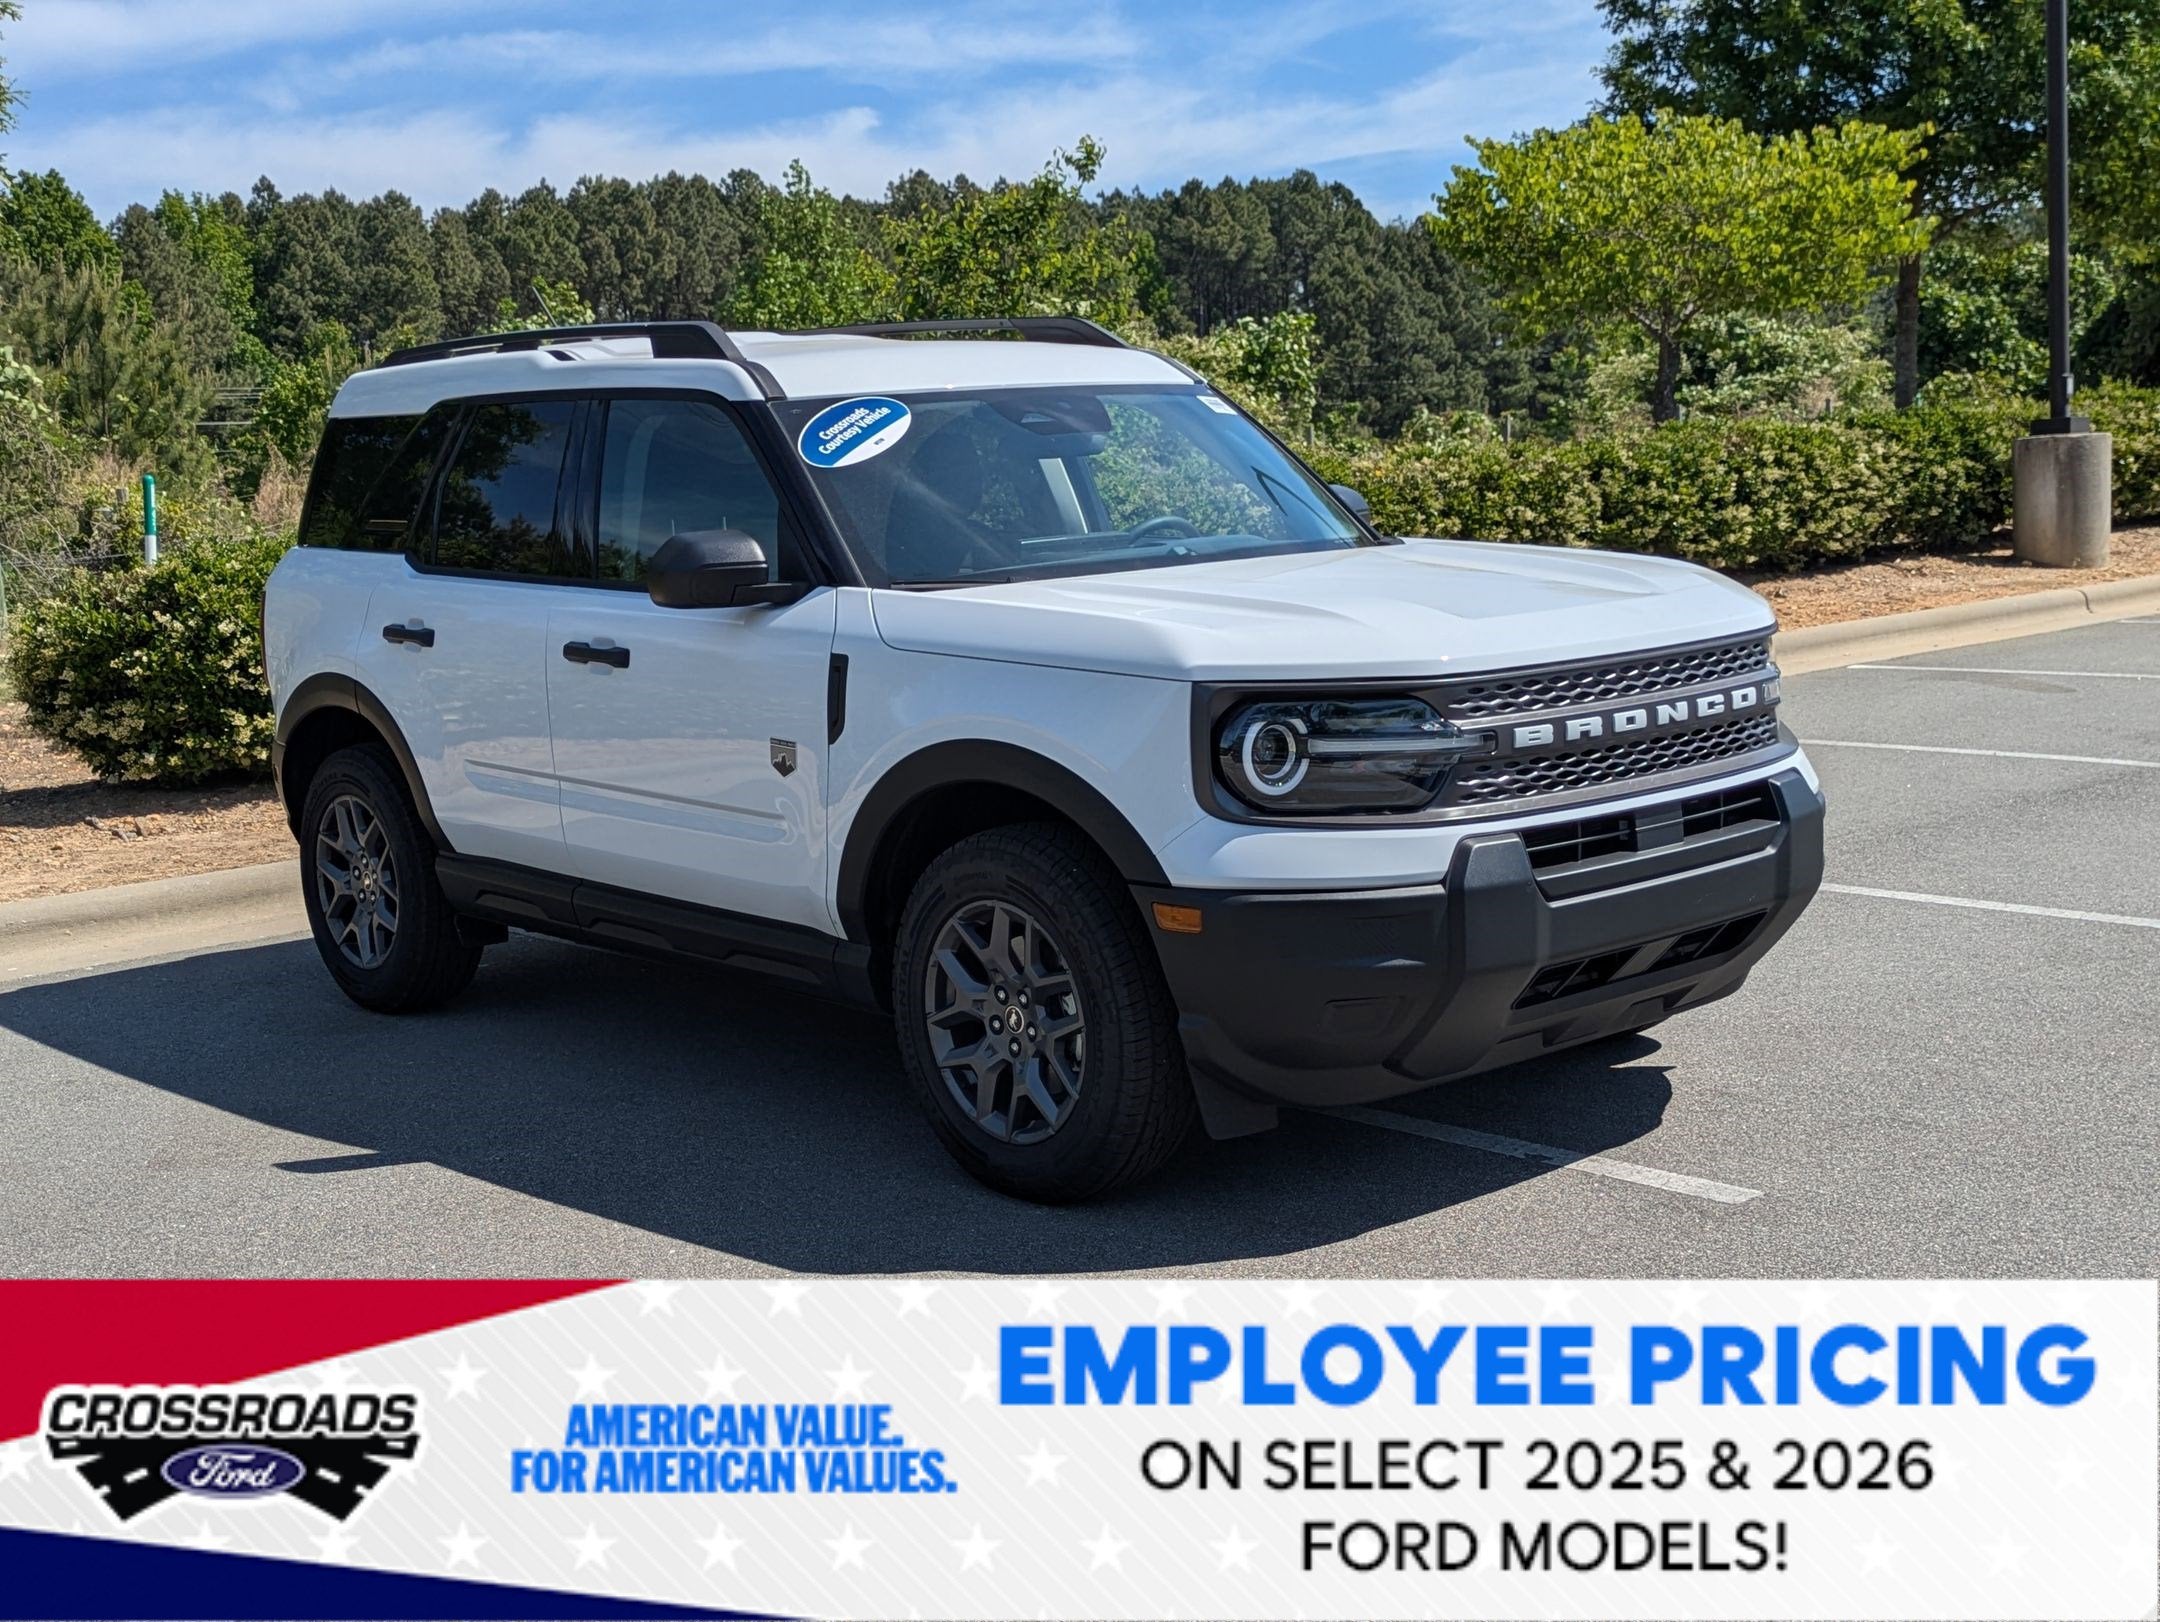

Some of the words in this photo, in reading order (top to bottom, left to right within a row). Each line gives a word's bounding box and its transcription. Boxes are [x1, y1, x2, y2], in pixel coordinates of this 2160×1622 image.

[818, 406, 870, 440] Crossroads
[818, 425, 862, 454] Courtesy
[854, 406, 892, 428] Vehicle
[1512, 686, 1758, 749] BRONCO
